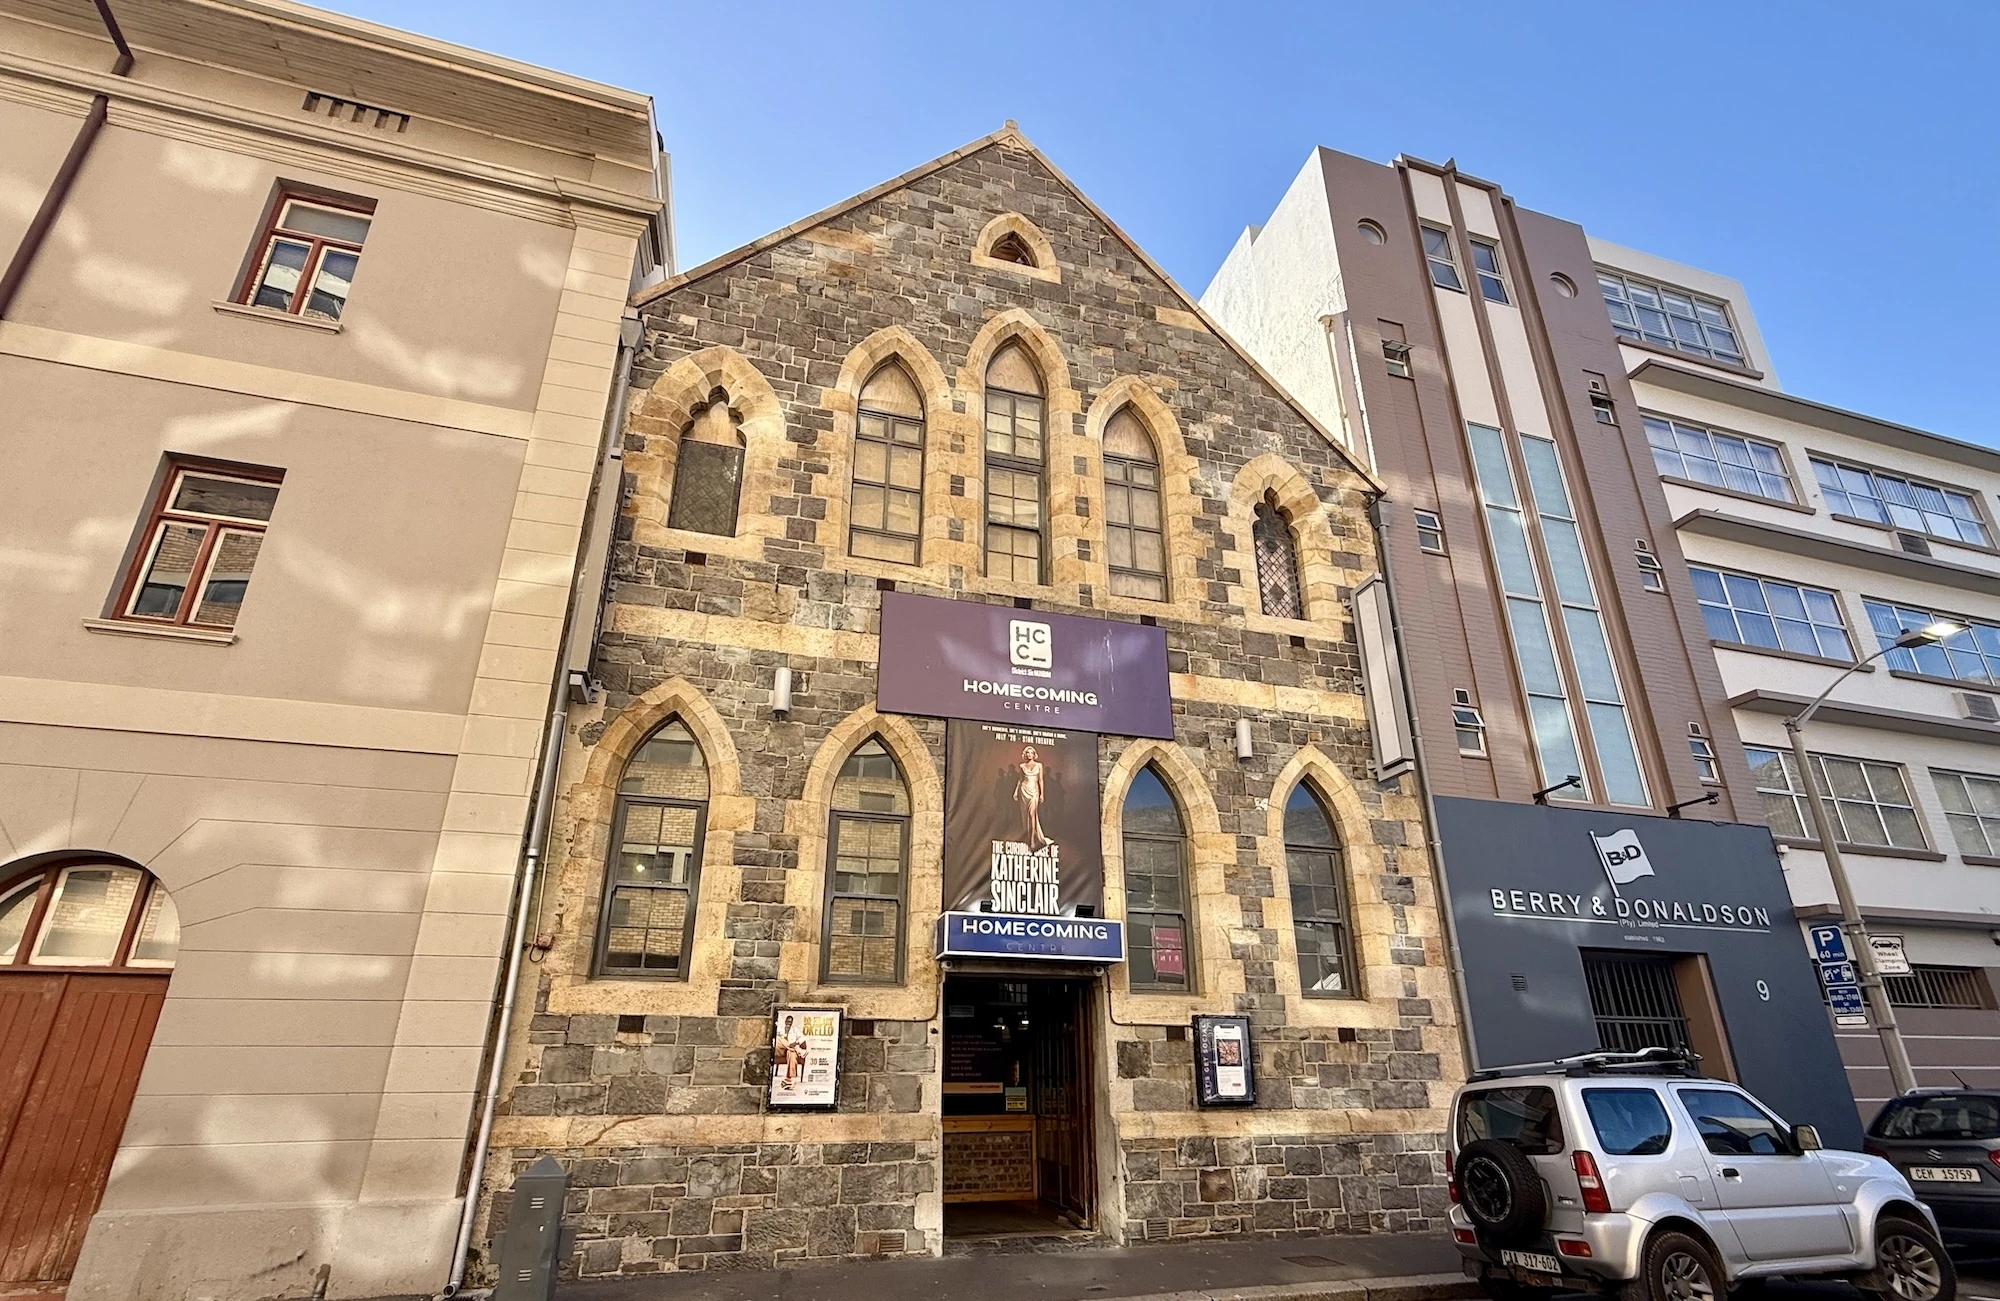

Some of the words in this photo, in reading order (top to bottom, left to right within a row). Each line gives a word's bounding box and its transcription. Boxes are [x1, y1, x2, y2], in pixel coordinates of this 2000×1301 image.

[963, 679, 1098, 705] HOMECOMING
[1004, 701, 1060, 714] CENTRE
[1022, 735, 1034, 744] STAR
[1035, 736, 1055, 746] THEATRE
[991, 840, 1004, 854] THE
[1050, 844, 1059, 858] OF
[1606, 844, 1642, 866] B&D
[991, 853, 1060, 884] KATHERINE
[991, 879, 1060, 915] SINCLAIR
[1491, 888, 1581, 915] BERRY
[1591, 896, 1607, 917] &
[1614, 898, 1771, 927] DONALDSON
[962, 918, 1108, 940] HOMECOMING
[1619, 919, 1636, 928] (Pty)
[1637, 920, 1660, 928] Limited
[1006, 942, 1067, 953] CENTRE
[1818, 930, 1834, 947] P
[1820, 950, 1831, 959] 60
[1756, 979, 1770, 1001] 9
[802, 1025, 834, 1037] OKELLO
[1915, 1168, 1935, 1179] CEM
[1941, 1169, 1972, 1180] 15759
[1523, 1253, 1559, 1271] 317-602
